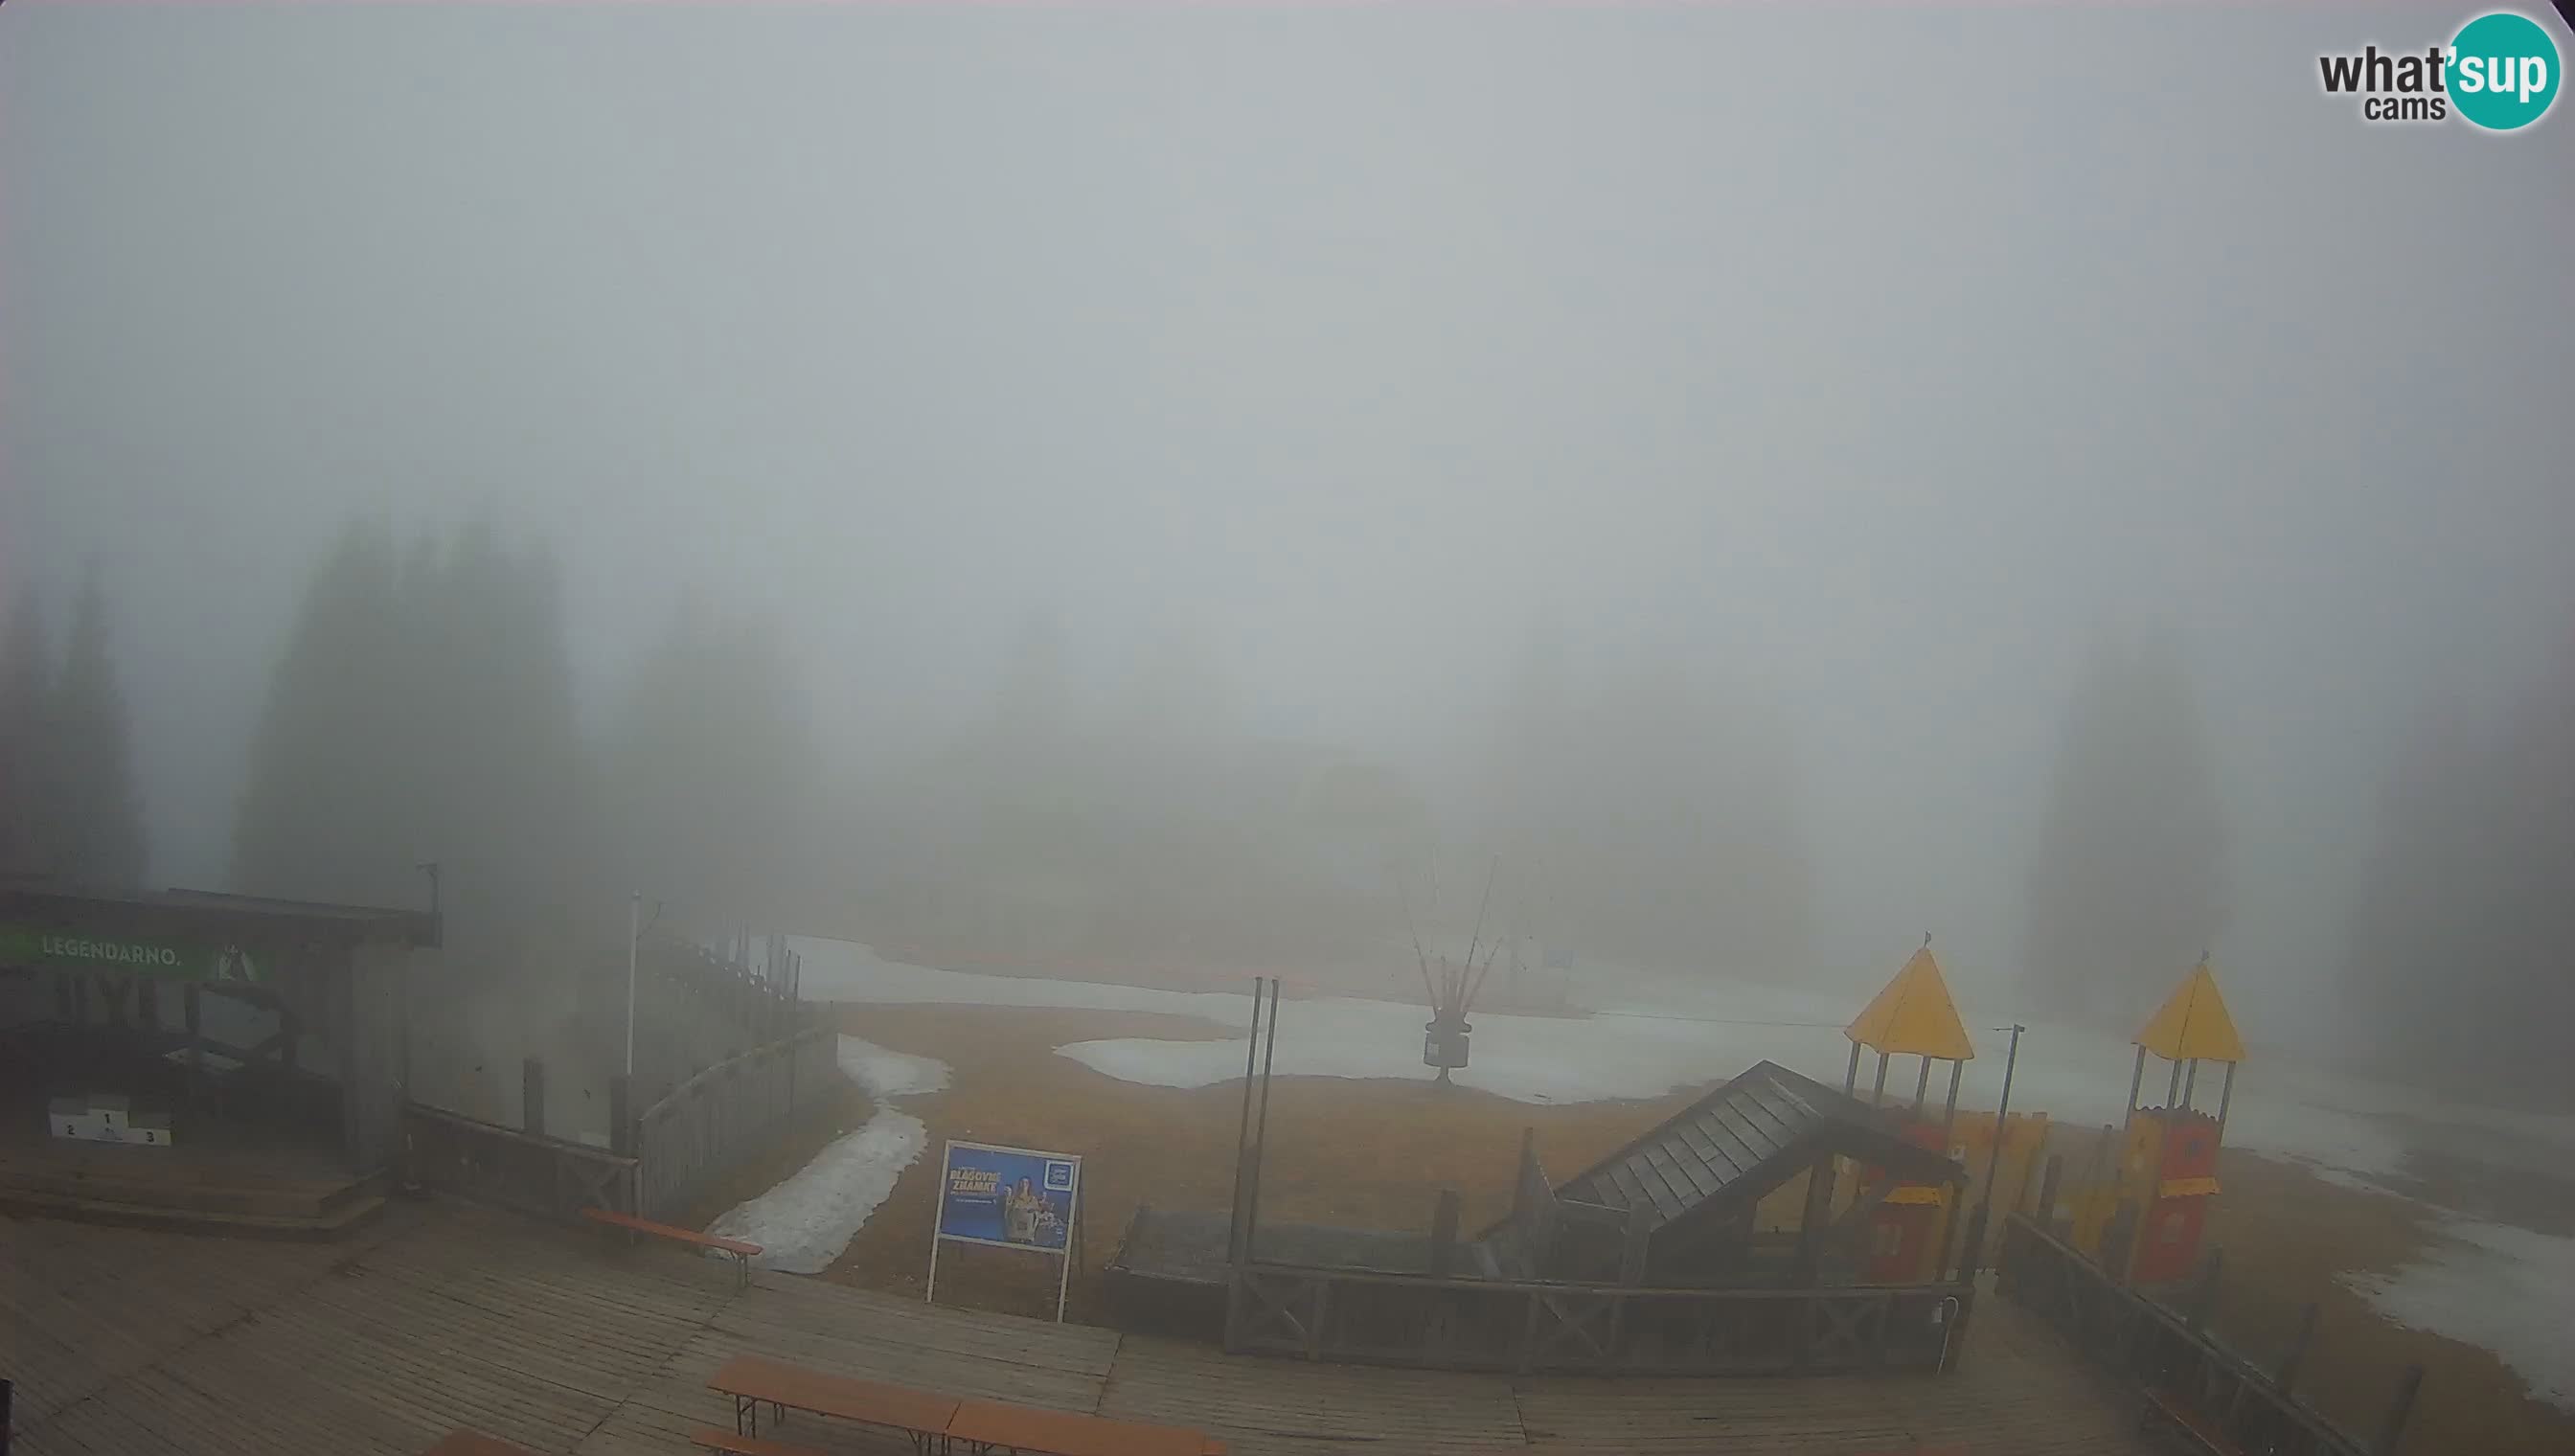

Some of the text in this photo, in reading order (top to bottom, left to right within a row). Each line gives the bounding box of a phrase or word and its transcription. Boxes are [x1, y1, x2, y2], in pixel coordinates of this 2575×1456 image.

[42, 934, 182, 967] LEGENDARNO.
[103, 1113, 111, 1125] 1
[67, 1125, 76, 1135] 2
[146, 1131, 155, 1143] 3
